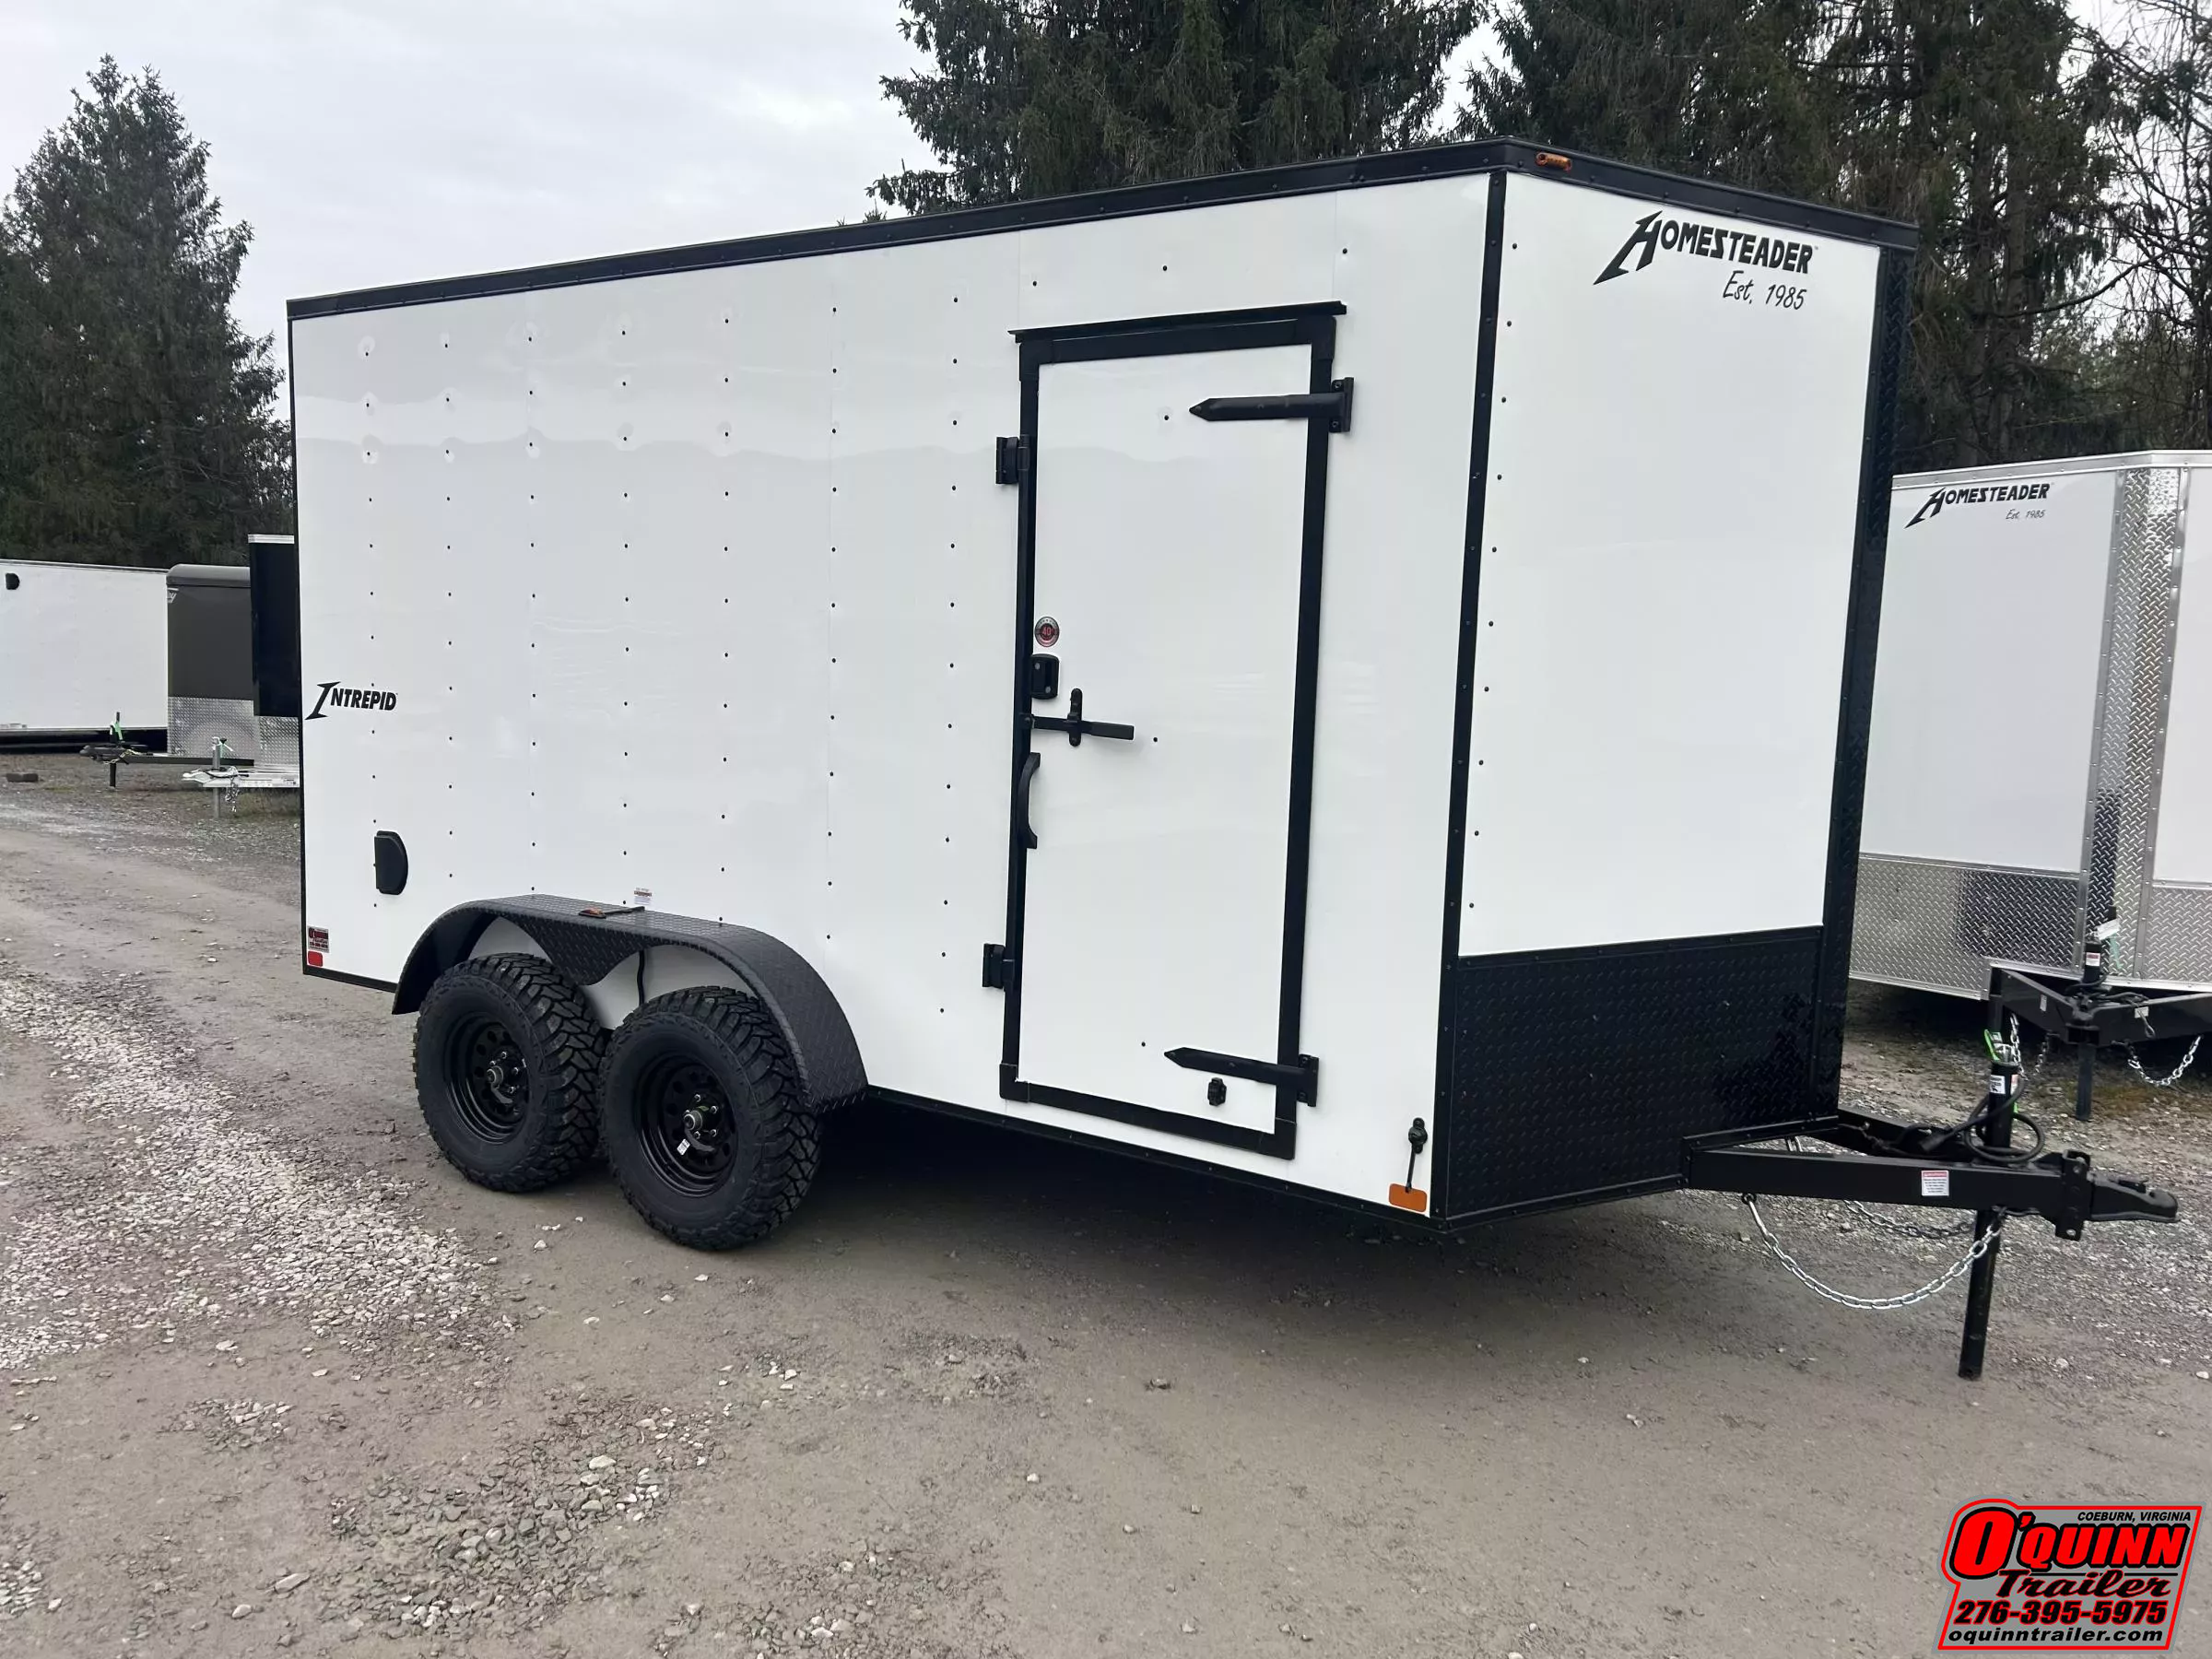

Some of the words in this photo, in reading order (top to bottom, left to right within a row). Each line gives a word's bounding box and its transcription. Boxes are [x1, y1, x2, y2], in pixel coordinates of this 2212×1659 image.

[1593, 210, 1813, 285] HOMESTEADER
[1765, 284, 1807, 310] 1985
[1904, 483, 2051, 529] HOMESTEADER
[2026, 509, 2046, 519] 1985
[304, 681, 397, 720] INTREPID
